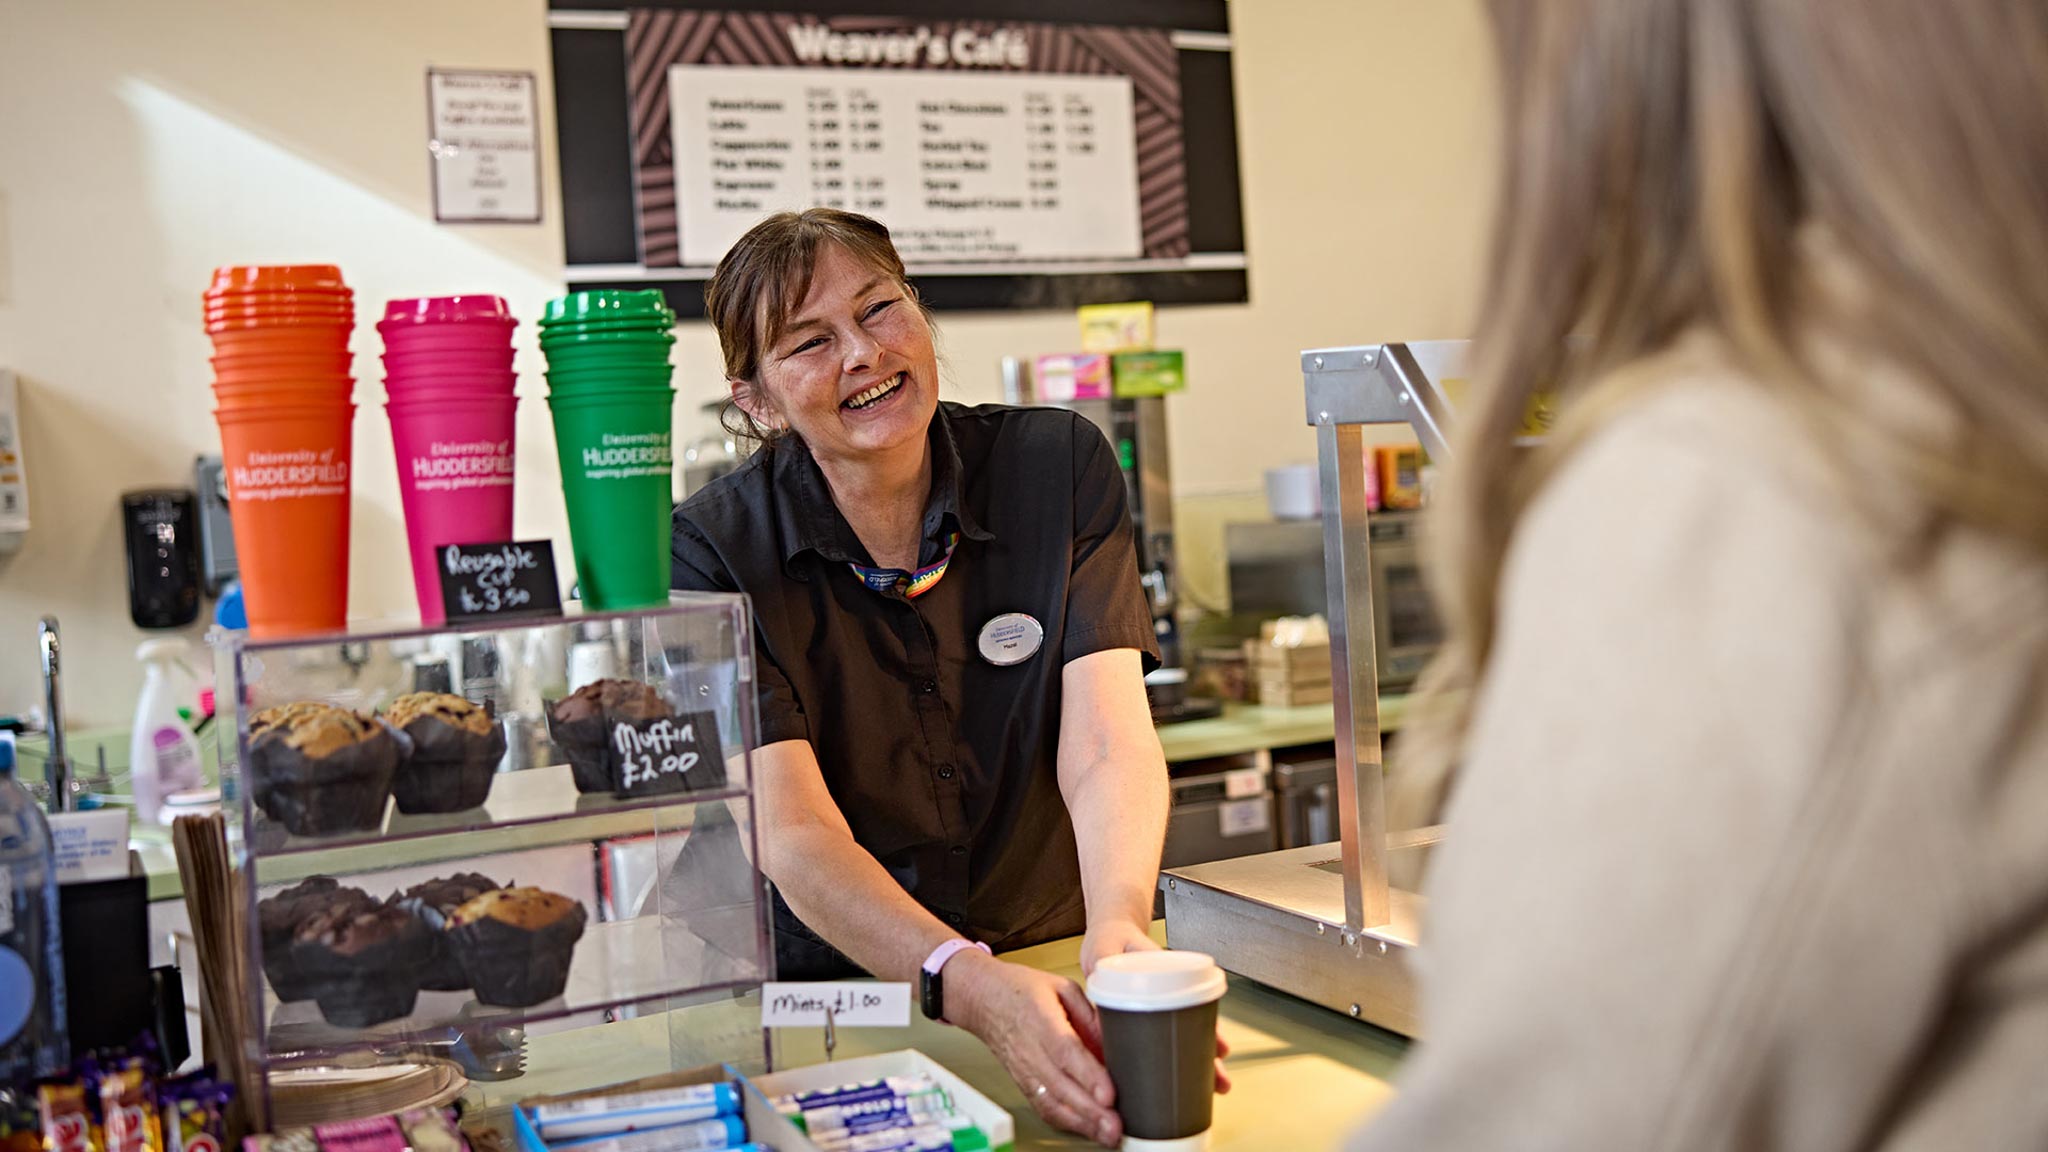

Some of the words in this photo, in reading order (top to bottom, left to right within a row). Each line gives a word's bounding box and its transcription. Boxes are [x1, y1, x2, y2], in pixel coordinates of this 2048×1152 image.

[787, 24, 949, 64] Weaver's
[952, 28, 1029, 67] Café
[248, 449, 317, 465] University
[320, 448, 334, 464] of
[431, 441, 496, 456] University
[233, 461, 347, 487] HUDDERSFIELD
[445, 544, 538, 575] Reusable
[614, 719, 695, 755] Muffin
[622, 750, 699, 789] £2.00
[772, 993, 825, 1015] Mints
[834, 989, 881, 1015] £1.00
